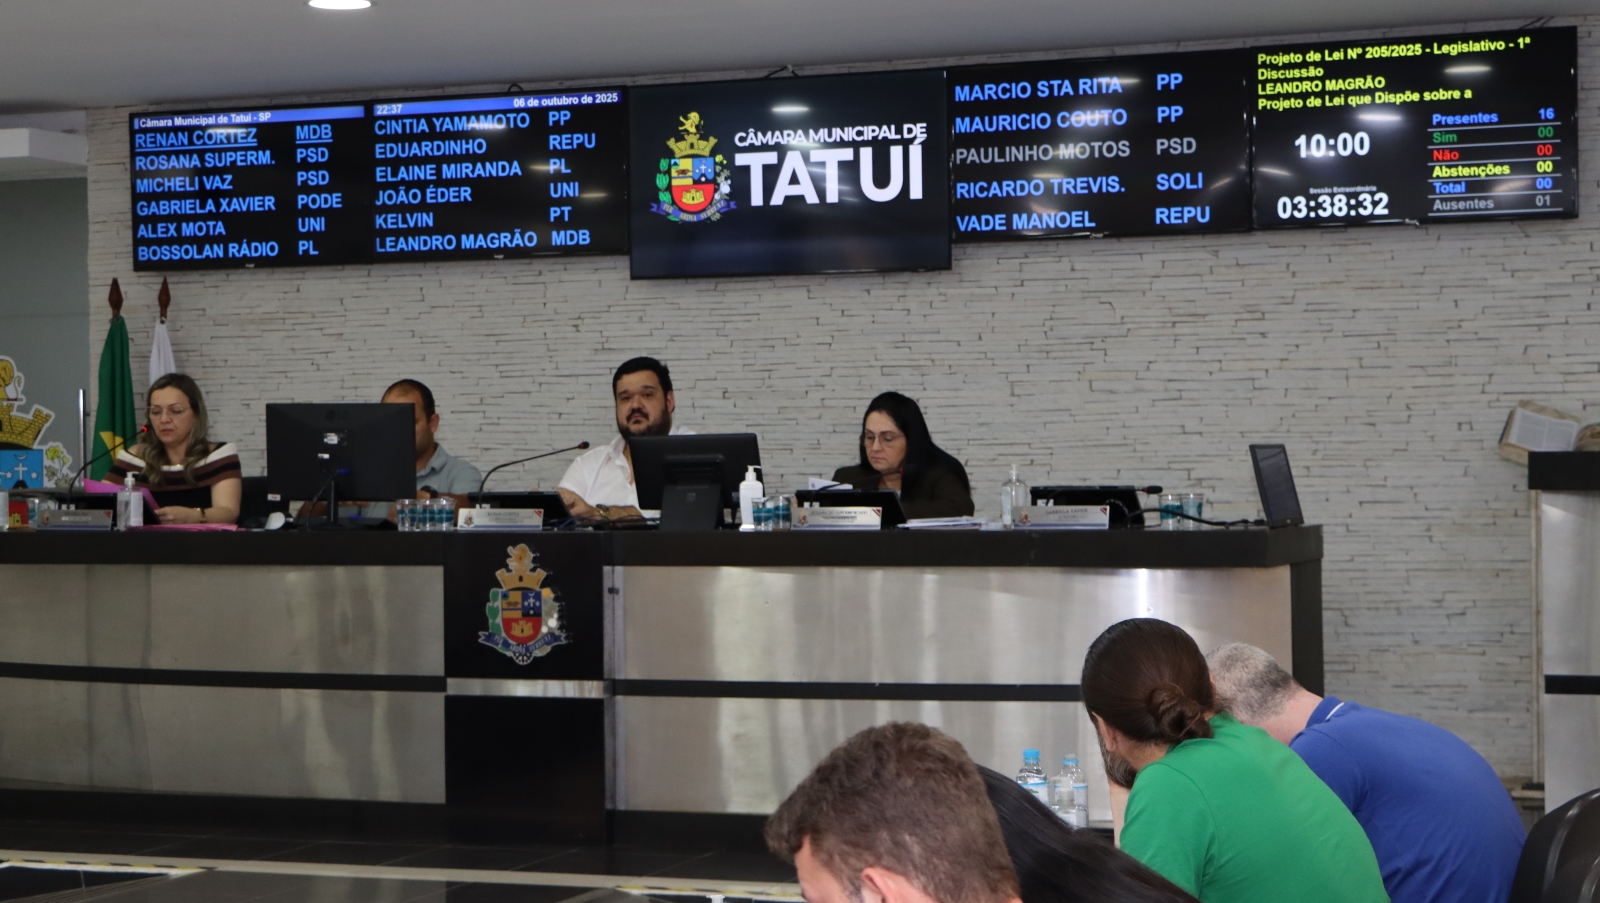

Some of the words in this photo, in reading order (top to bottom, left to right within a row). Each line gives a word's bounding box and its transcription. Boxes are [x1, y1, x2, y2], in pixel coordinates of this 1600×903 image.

[1258, 53, 1303, 66] Projeto
[1306, 51, 1322, 62] de
[1325, 49, 1344, 61] Lei
[1347, 48, 1363, 60] Nº
[1365, 43, 1422, 59] 205/2025
[1433, 39, 1506, 56] Legislativo
[1517, 37, 1531, 49] 1ª
[1258, 66, 1324, 80] Discussão
[955, 82, 1032, 102] MARCIO
[1036, 79, 1074, 98] STA
[1078, 76, 1123, 95] RITA
[1156, 73, 1183, 91] PP
[1258, 81, 1322, 95] LEANDRO
[1325, 75, 1386, 91] MAGRÃO
[377, 104, 402, 114] 22:37
[513, 98, 526, 108] 06
[527, 97, 540, 107] de
[541, 96, 579, 106] outubro
[581, 95, 593, 104] de
[595, 93, 618, 103] 2025
[1258, 98, 1303, 111] Projeto
[1306, 96, 1322, 107] de
[1325, 95, 1344, 106] Lei
[1348, 95, 1372, 107] que
[1375, 90, 1420, 105] Dispõe
[1423, 88, 1461, 101] sobre
[1464, 89, 1473, 98] a
[140, 118, 172, 128] Câmara
[174, 115, 216, 126] Municipal
[217, 114, 228, 124] de
[258, 111, 272, 121] SP
[375, 118, 429, 135] CINTIA
[432, 112, 530, 132] YAMAMOTO
[549, 110, 571, 126] PP
[955, 112, 1051, 133] MAURICIO
[1057, 108, 1128, 128] COUTO
[1157, 106, 1183, 123] PP
[1432, 112, 1498, 126] Presentes
[1538, 108, 1555, 120] 16
[135, 131, 188, 148] RENAN
[193, 128, 257, 145] CORTEZ
[296, 124, 332, 140] MDB
[375, 138, 486, 158] EDUARDINHO
[549, 133, 595, 150] REPU
[734, 128, 806, 147] CÂMARA
[809, 124, 901, 144] MUNICIPAL
[903, 123, 927, 138] DE
[1294, 131, 1371, 158] 10:00
[1432, 132, 1457, 143] Sim
[1538, 126, 1554, 138] 00
[136, 154, 201, 170] ROSANA
[204, 150, 275, 167] SUPERM.
[296, 147, 329, 163] PSD
[956, 144, 1053, 165] PAULINHO
[1058, 140, 1131, 160] MOTOS
[1156, 137, 1197, 155] PSD
[1433, 149, 1459, 161] Não
[1537, 144, 1553, 156] 00
[376, 164, 437, 182] ELAINE
[442, 160, 522, 179] MIRANDA
[549, 158, 571, 174] PL
[735, 137, 927, 206] TATUÍ
[1432, 163, 1510, 178] Abstenções
[1536, 161, 1553, 173] 00
[136, 177, 199, 193] MICHELI
[202, 175, 233, 190] VAZ
[297, 170, 329, 186] PSD
[956, 178, 1044, 199] RICARDO
[1050, 175, 1126, 195] TREVIS.
[1156, 172, 1203, 191] SOLI
[1433, 181, 1466, 194] Total
[1536, 177, 1553, 189] 00
[137, 199, 216, 216] GABRIELA
[219, 196, 276, 212] XAVIER
[298, 193, 342, 209] PODE
[375, 186, 421, 205] JOÃO
[426, 184, 472, 204] ÉDER
[550, 182, 579, 198] UNI
[1433, 198, 1494, 211] Ausentes
[1536, 195, 1551, 207] 01
[1277, 192, 1389, 219] 03:38:32
[137, 223, 177, 238] ALEX
[181, 221, 226, 236] MOTA
[298, 217, 325, 232] UNI
[376, 212, 434, 229] KELVIN
[550, 206, 572, 222] PT
[956, 214, 1007, 232] VADE
[1012, 211, 1096, 230] MANOEL
[1155, 206, 1211, 225] REPU
[138, 244, 224, 260] BOSSOLAN
[228, 240, 278, 258] RÁDIO
[298, 241, 319, 255] PL
[376, 234, 457, 252] LEANDRO
[461, 229, 537, 250] MAGRÃO
[551, 230, 590, 246] MDB
